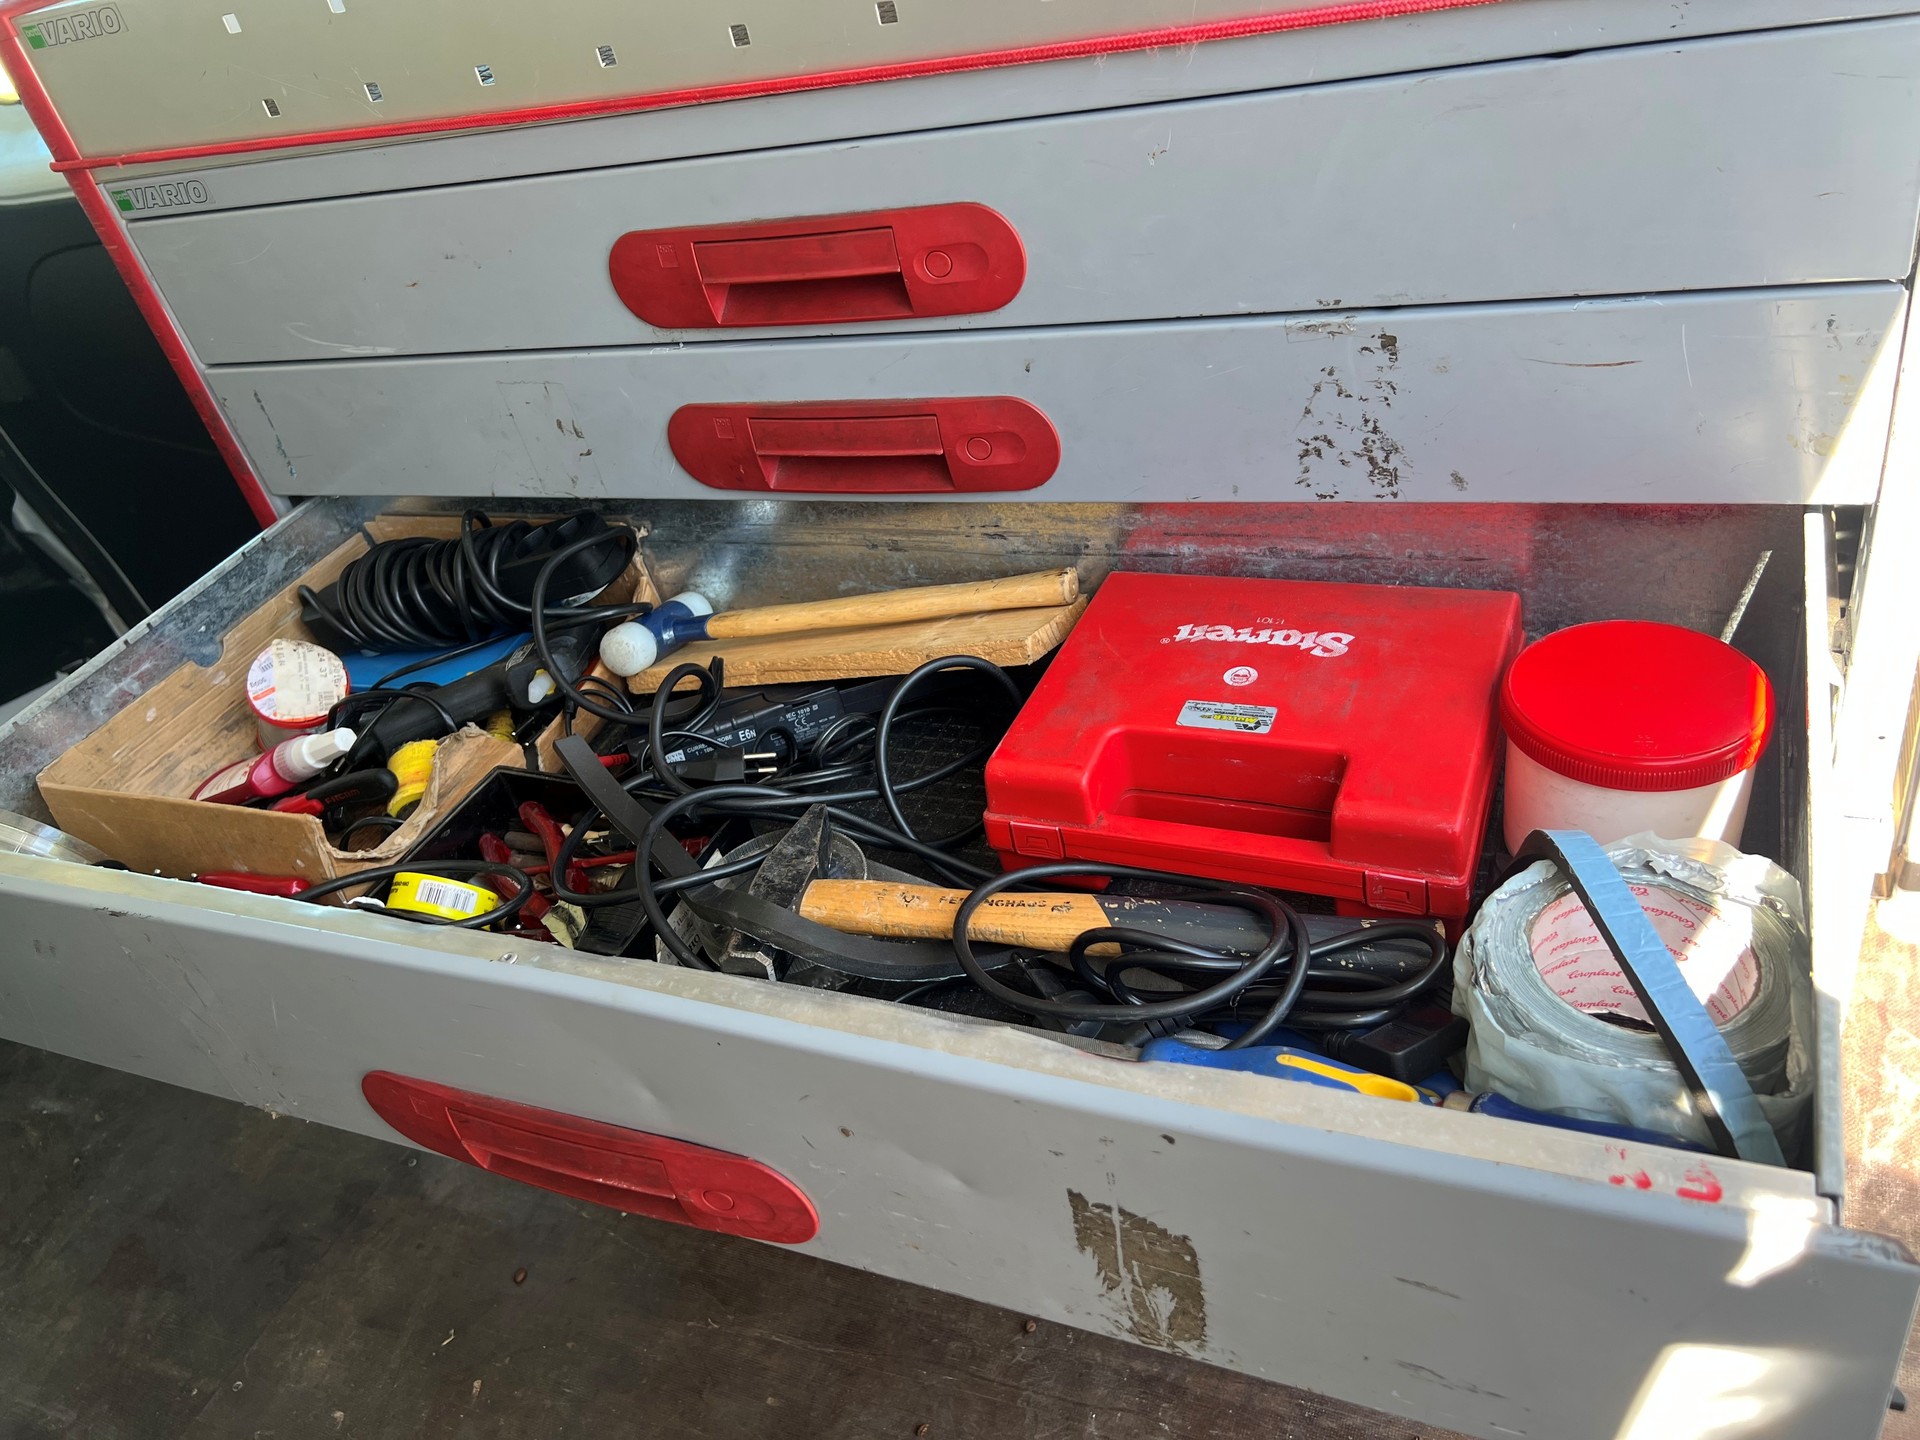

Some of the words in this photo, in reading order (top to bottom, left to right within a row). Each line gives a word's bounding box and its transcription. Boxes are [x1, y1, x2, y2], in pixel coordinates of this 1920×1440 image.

[37, 7, 121, 46] VARIO
[126, 180, 208, 210] VARIO
[1173, 623, 1356, 657] Starrett
[785, 711, 797, 719] IEC
[1567, 968, 1622, 979] Coroplast
